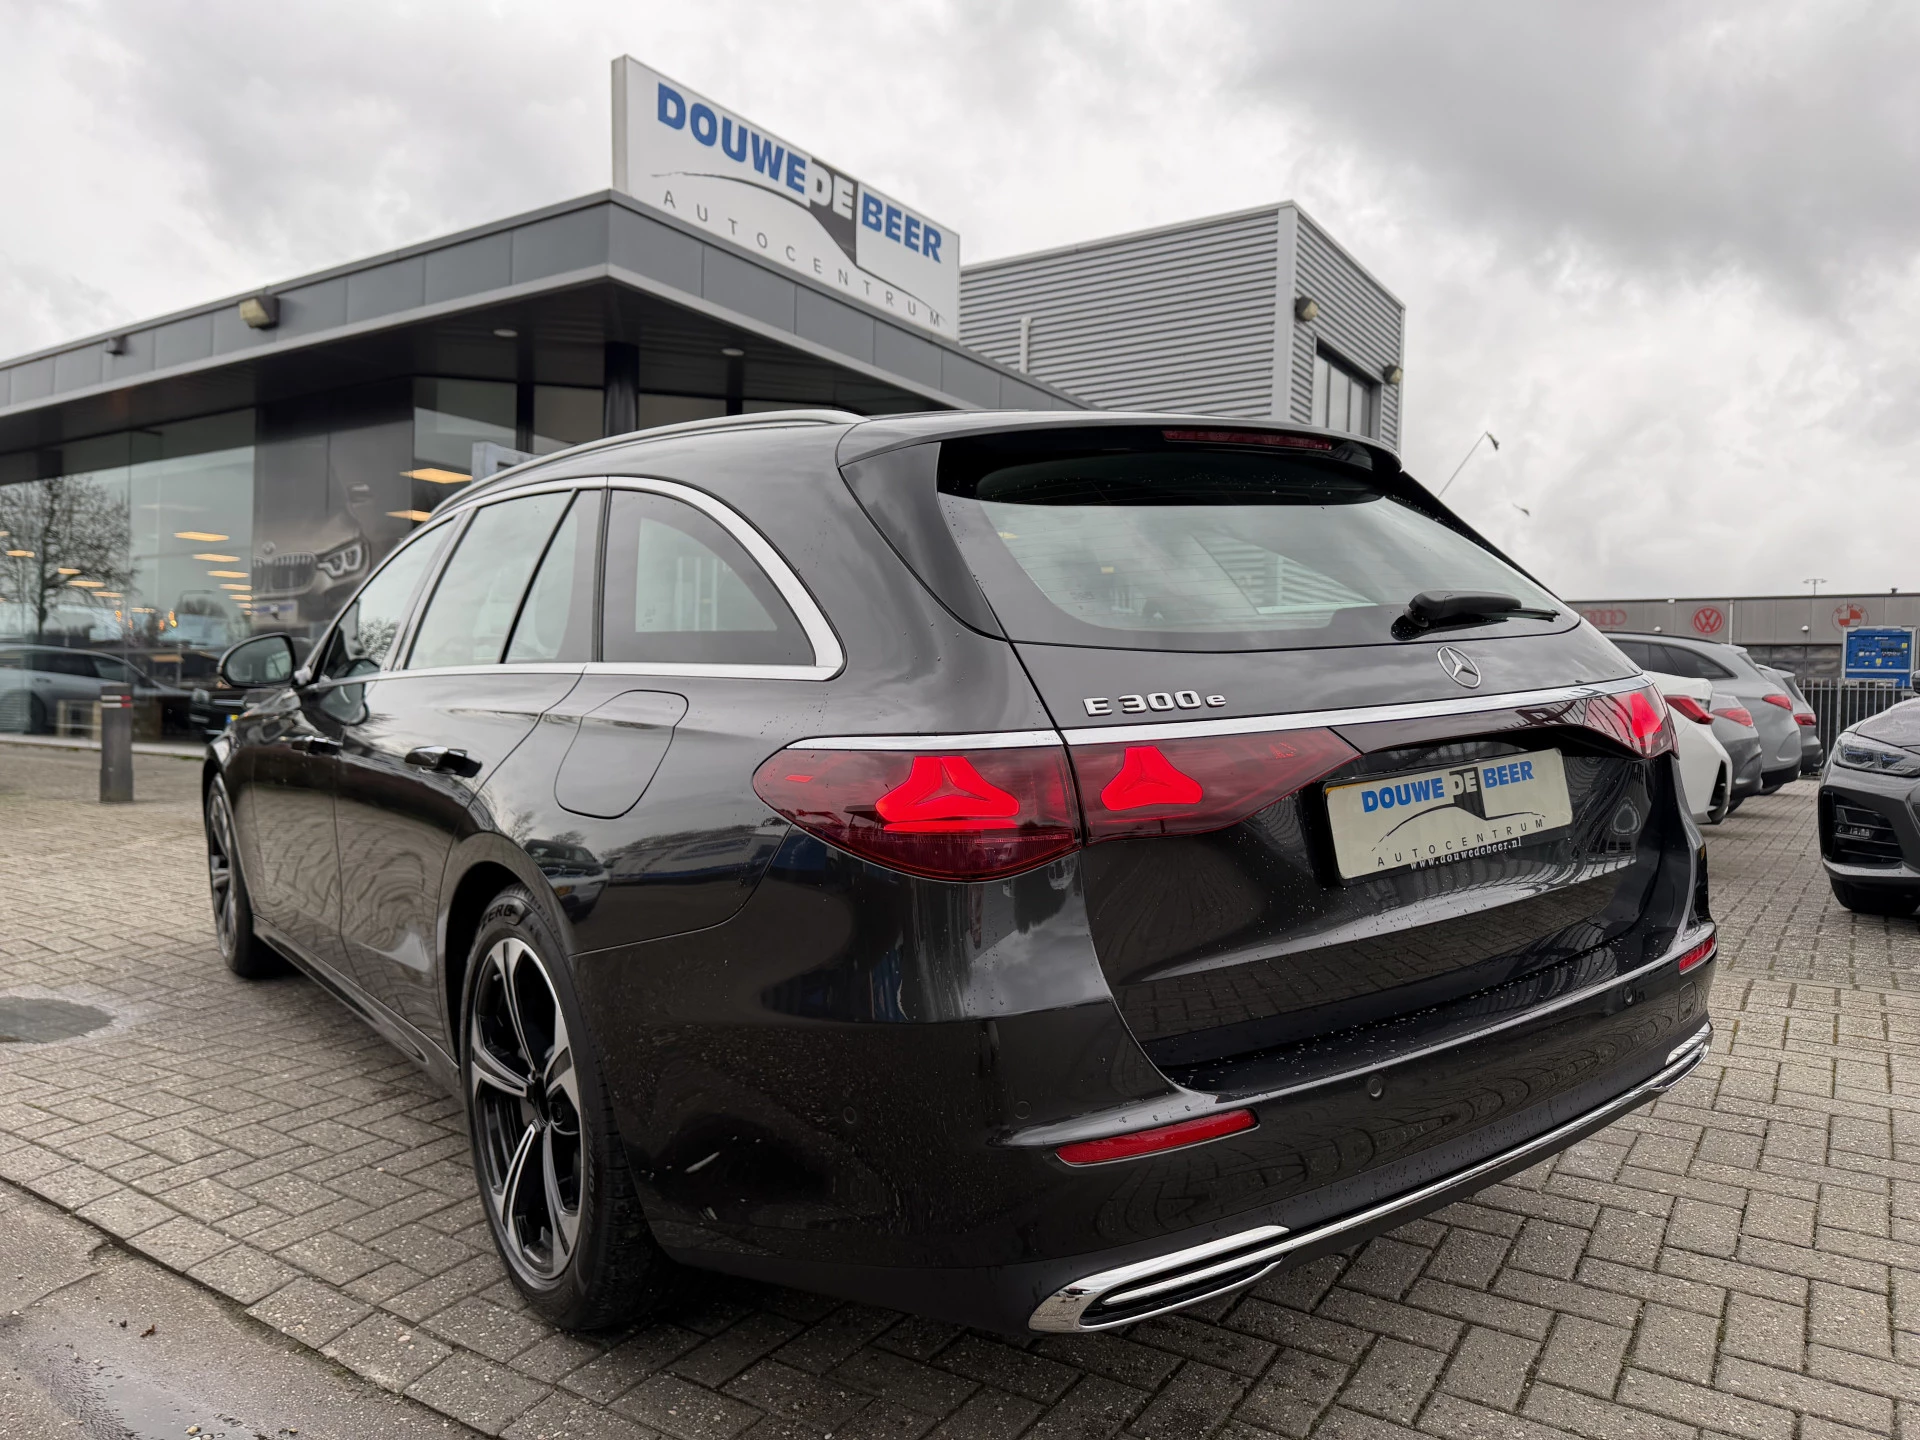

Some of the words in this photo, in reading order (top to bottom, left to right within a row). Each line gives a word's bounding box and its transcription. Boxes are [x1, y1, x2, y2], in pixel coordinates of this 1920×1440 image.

[657, 82, 806, 194] DOUWE
[808, 161, 854, 219] DE
[862, 192, 942, 264] BEER
[664, 191, 941, 327] AUTOCENTRUM
[1083, 697, 1112, 717] E
[1118, 690, 1201, 713] 300
[1206, 694, 1227, 707] e
[1361, 778, 1444, 813] DOUWE
[1452, 772, 1478, 796] DE
[1482, 761, 1534, 789] BEER
[1377, 819, 1544, 867] AUTOCENTRUM
[1410, 837, 1522, 870] www.douwedebeer.nl
